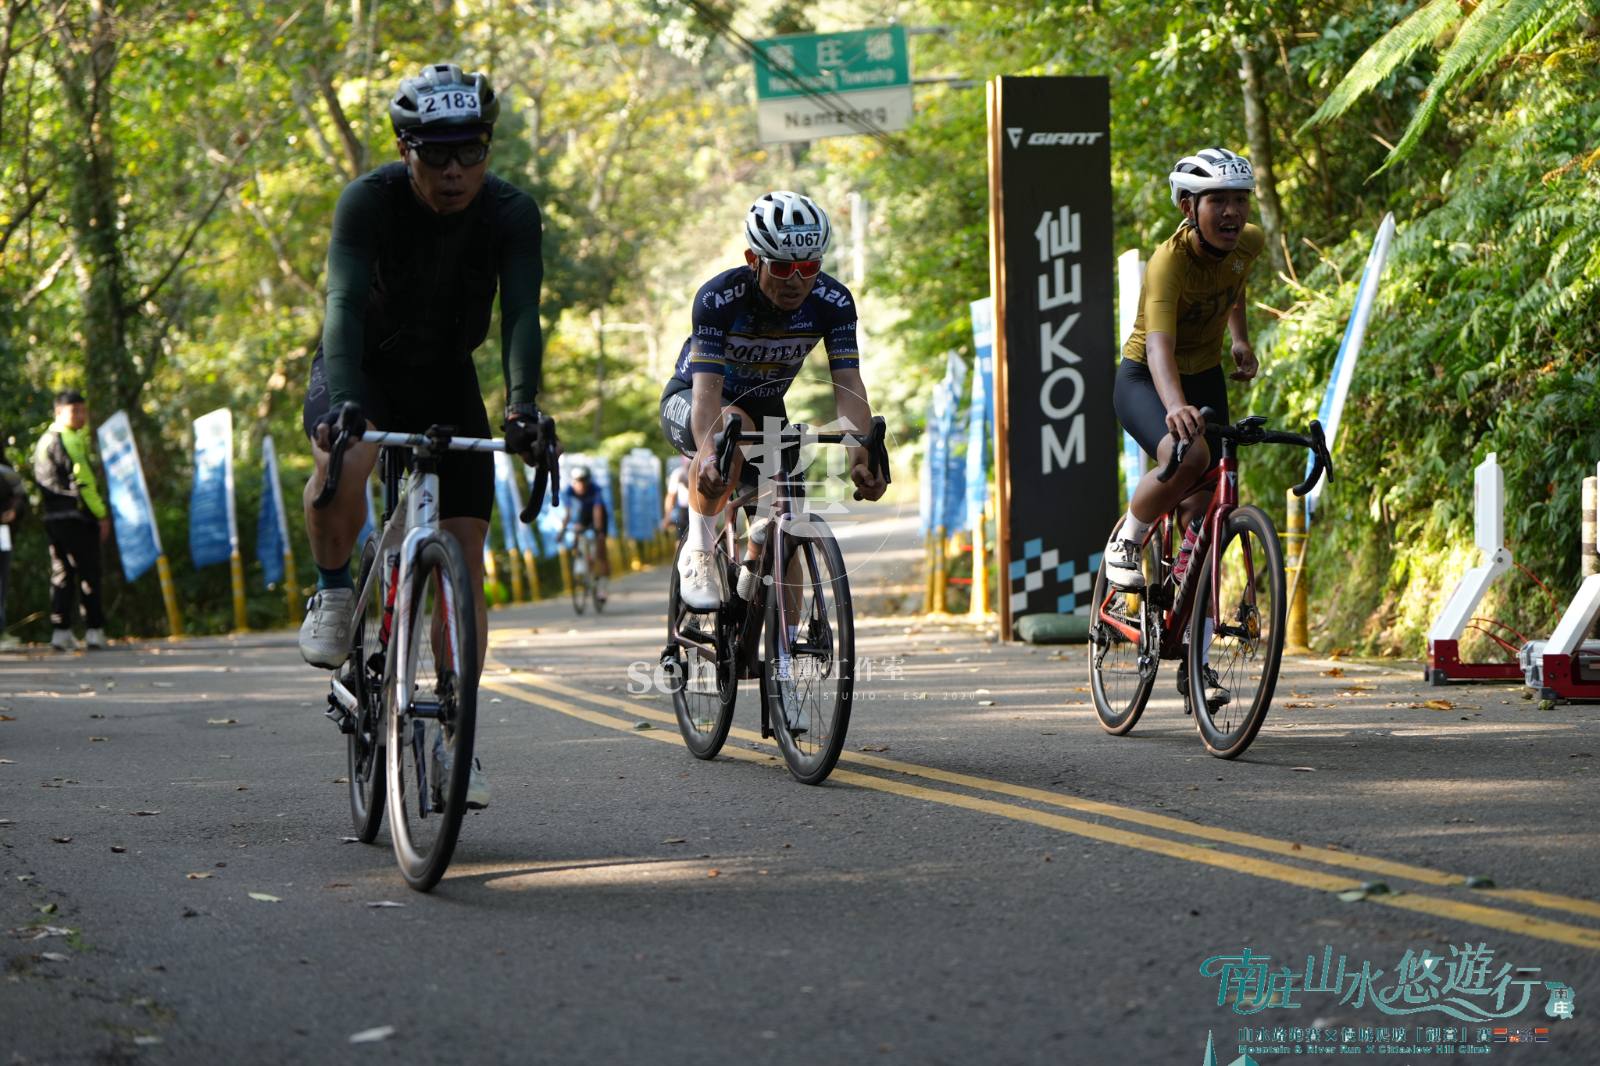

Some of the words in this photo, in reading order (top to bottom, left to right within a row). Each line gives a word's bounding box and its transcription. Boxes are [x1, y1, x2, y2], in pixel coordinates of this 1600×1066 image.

[424, 92, 477, 113] 2183
[1027, 131, 1103, 145] GIANT
[782, 232, 820, 247] 4067
